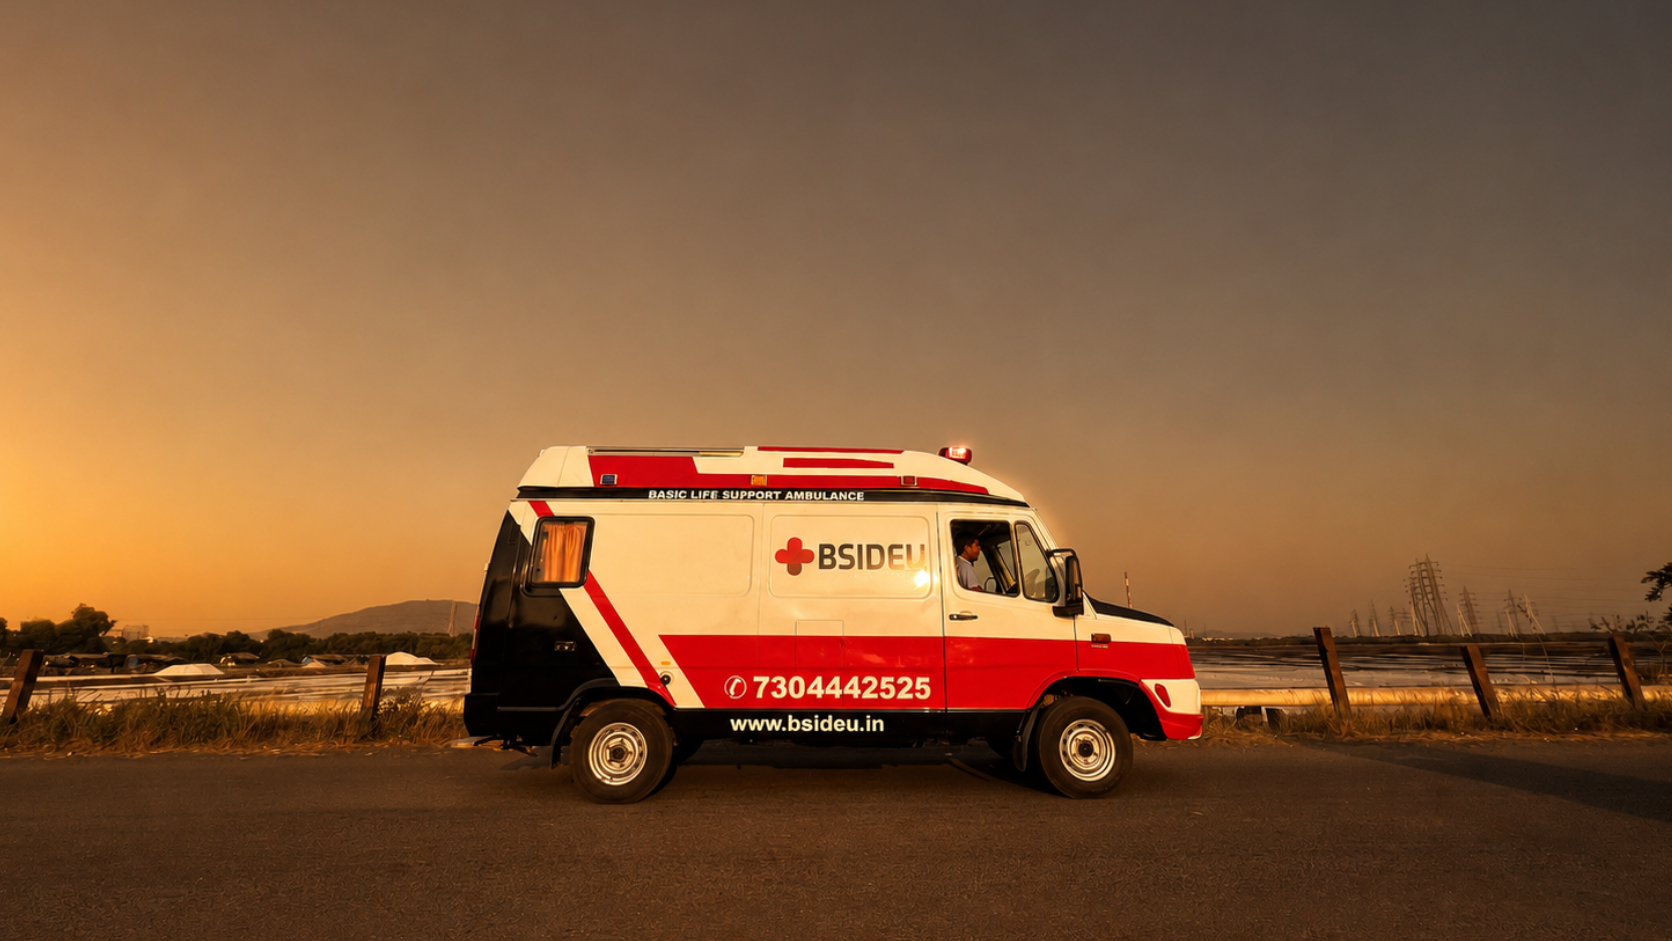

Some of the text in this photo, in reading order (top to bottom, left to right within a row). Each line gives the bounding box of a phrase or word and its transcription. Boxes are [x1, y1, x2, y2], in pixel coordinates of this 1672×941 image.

[648, 490, 865, 501] BASIC LIFE SUPPORT AMBULANCE
[818, 543, 926, 571] BSIDEU
[753, 675, 931, 700] 7304442525
[730, 714, 885, 733] www.bsideu.in
